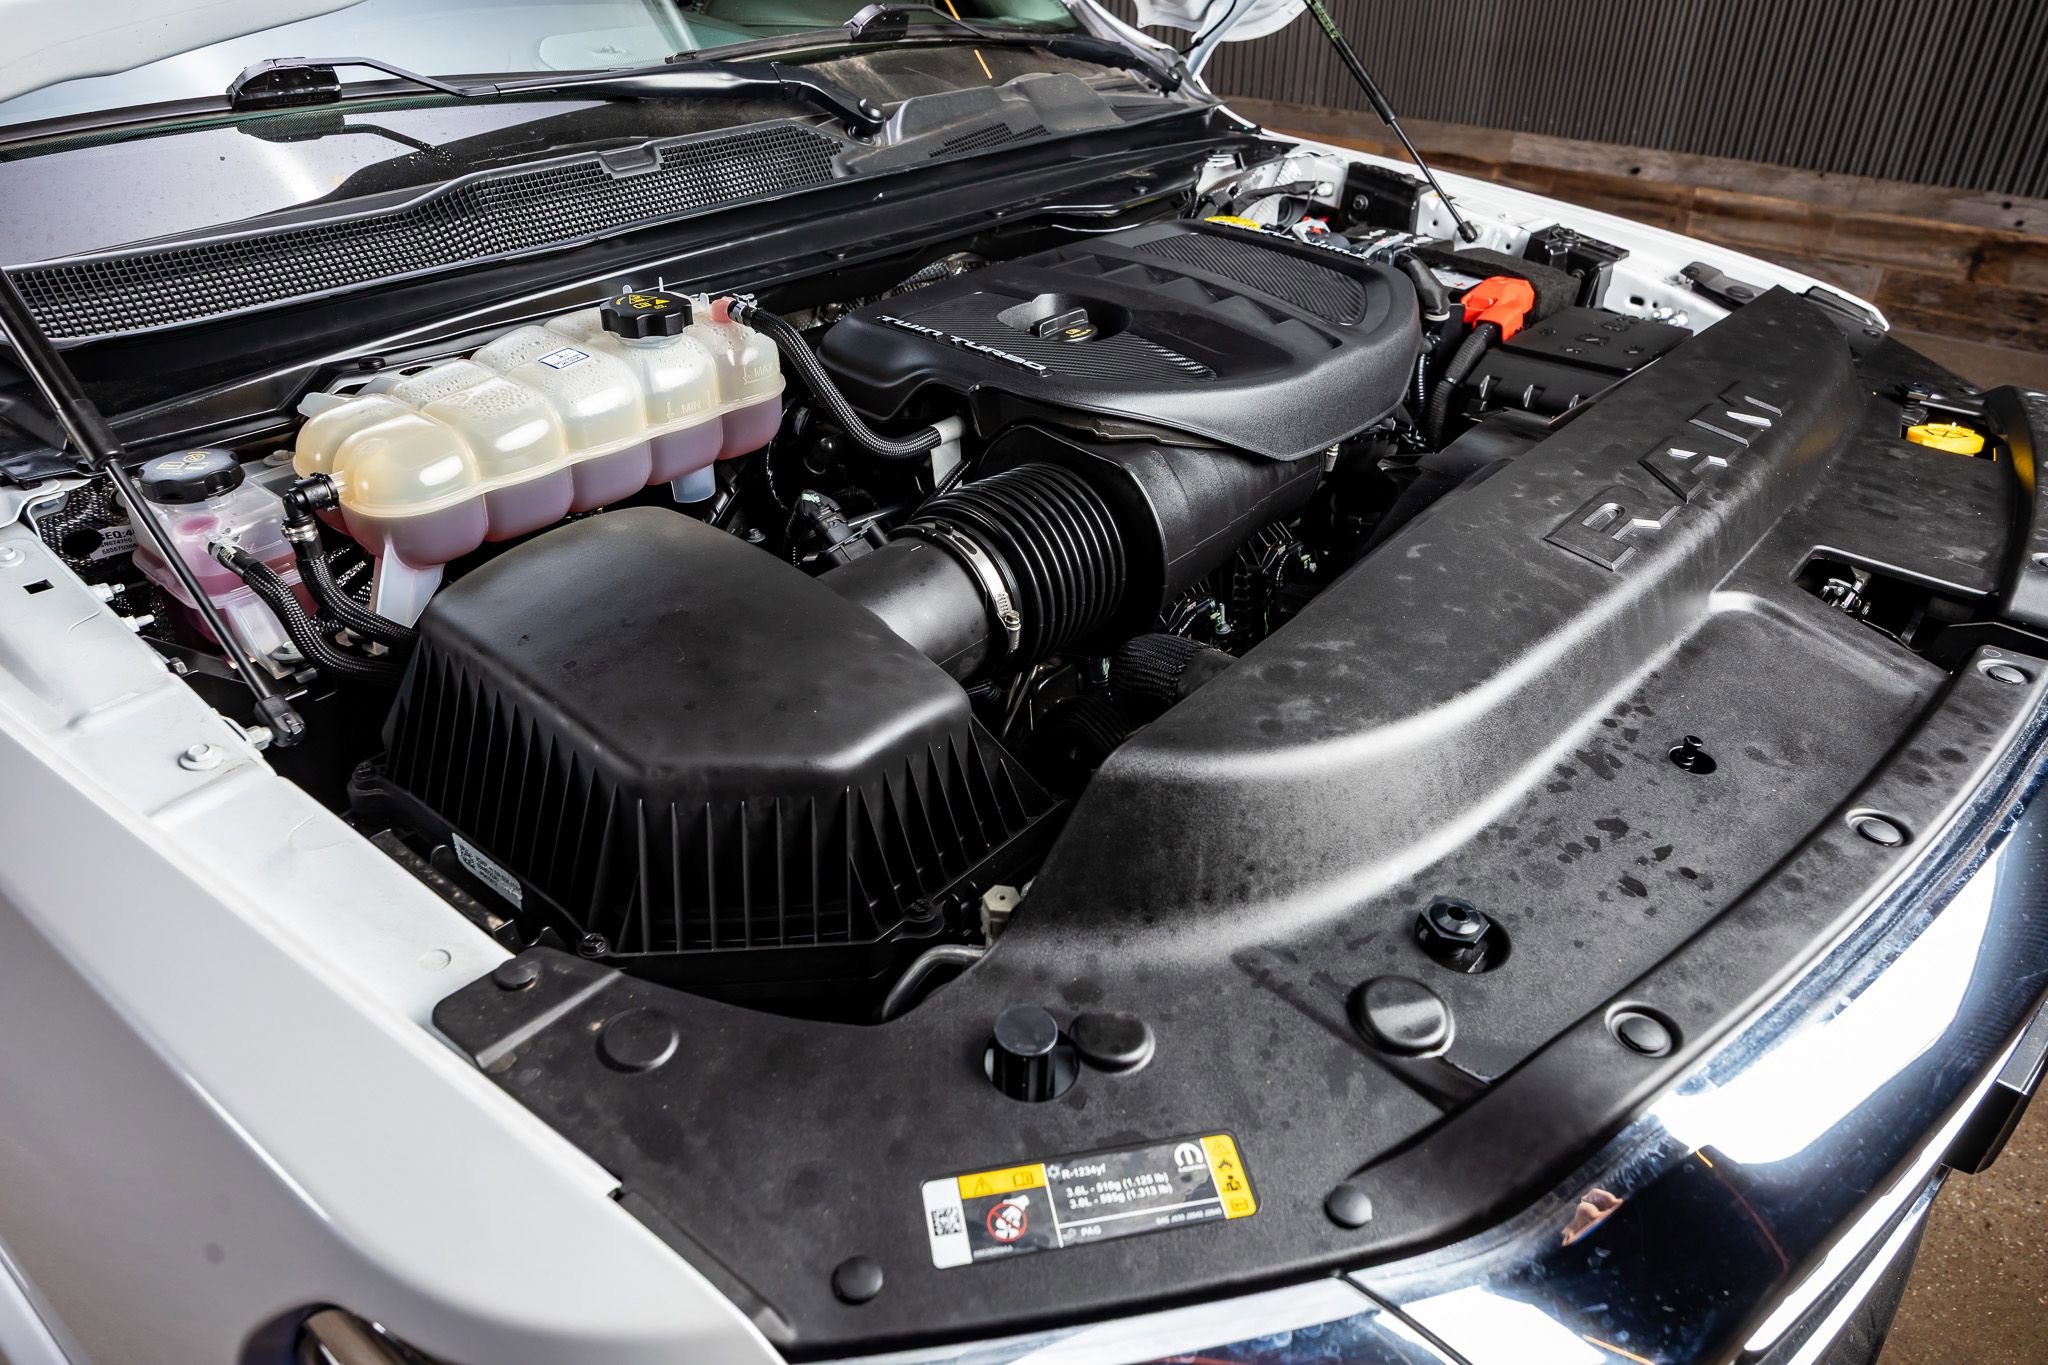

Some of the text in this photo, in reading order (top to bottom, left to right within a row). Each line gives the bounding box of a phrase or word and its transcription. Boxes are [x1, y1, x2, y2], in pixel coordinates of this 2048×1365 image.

[879, 315, 1047, 371] TWIN TURBO
[1542, 381, 1790, 572] RAM
[1062, 1163, 1106, 1180] R-1234yf
